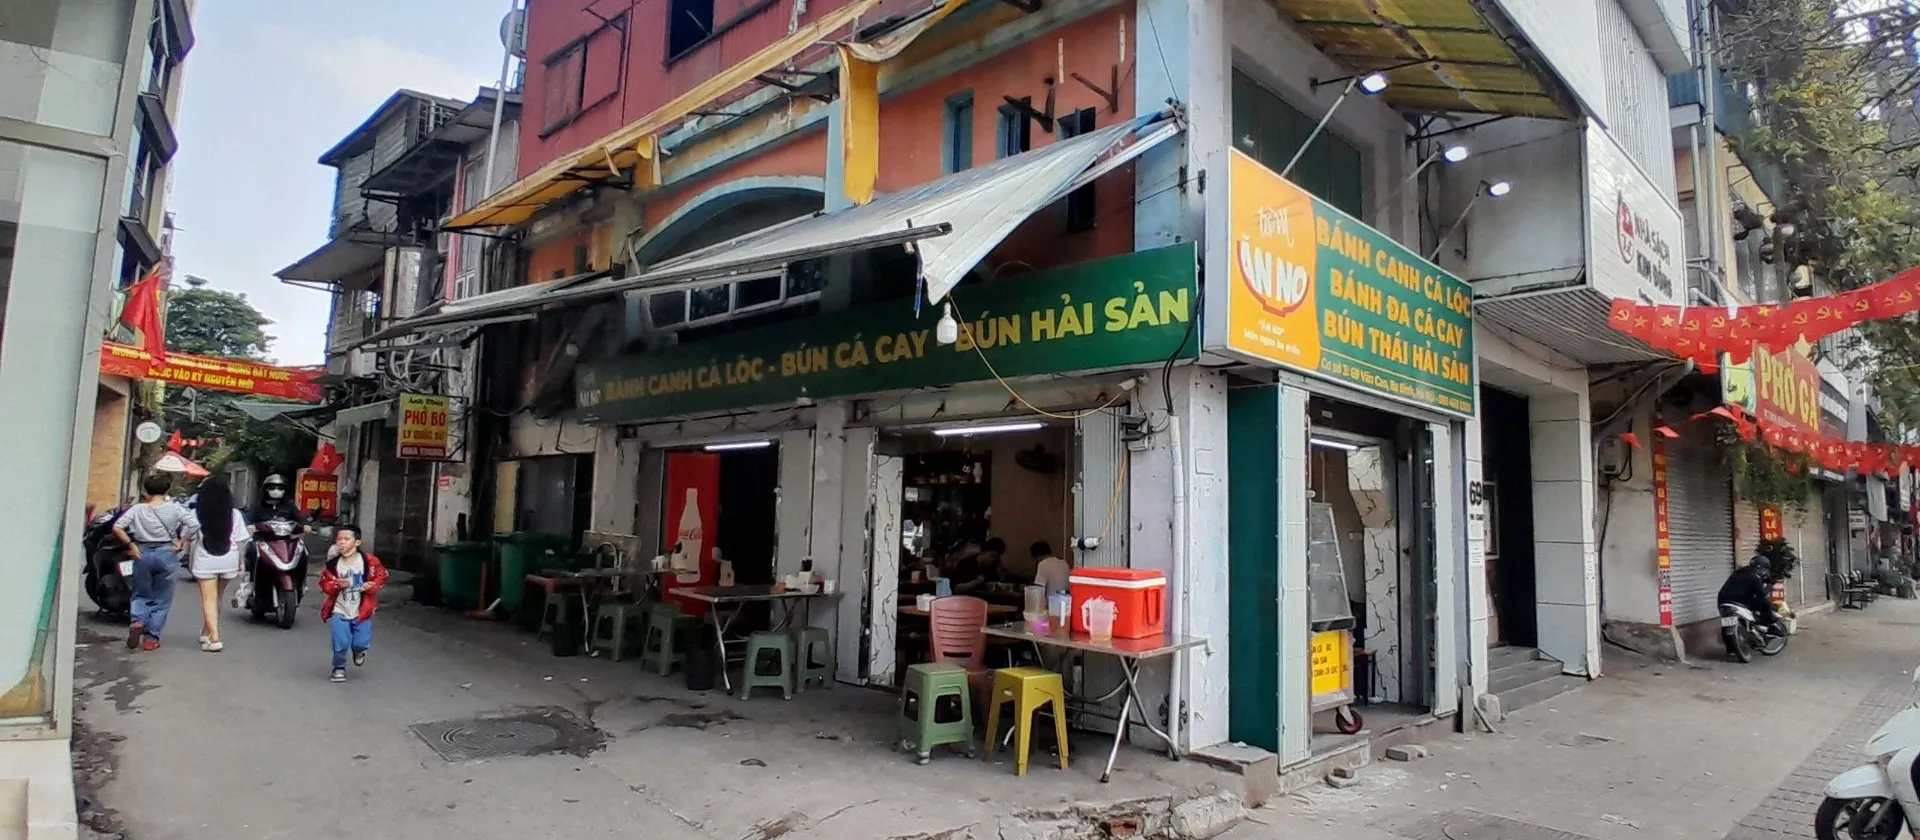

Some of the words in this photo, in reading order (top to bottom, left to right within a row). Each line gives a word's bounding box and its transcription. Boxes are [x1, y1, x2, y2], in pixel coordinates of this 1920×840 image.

[1240, 233, 1272, 298] ĂN
[1276, 257, 1308, 305] NO
[1316, 216, 1371, 268] BÁNH
[1375, 250, 1420, 293] CANH
[1424, 275, 1443, 304] CÁ
[1446, 286, 1472, 318] LÓC
[649, 367, 692, 396] CANH
[700, 358, 721, 388] CÁ
[726, 354, 764, 385] LÓC
[781, 343, 828, 377] BÚN
[835, 333, 869, 369] CÁ
[875, 330, 929, 364] CAY
[955, 311, 1022, 352] BÚN
[1031, 294, 1094, 342] HẢI
[1104, 281, 1189, 332] SẢN
[1323, 308, 1364, 349] BÚN
[1369, 327, 1409, 365] THÁI
[1412, 340, 1439, 375] HẢI
[1441, 351, 1469, 386] SẢN
[1330, 268, 1382, 316] BÁNH
[1386, 295, 1411, 328] ĐA
[1414, 307, 1436, 338] CÁ
[1436, 318, 1465, 349] CAY
[173, 367, 190, 379] VÀO
[1759, 345, 1796, 415] PHỞ
[1799, 373, 1820, 432] GÀ
[404, 405, 428, 425] PHỞ
[1469, 480, 1482, 506] 69
